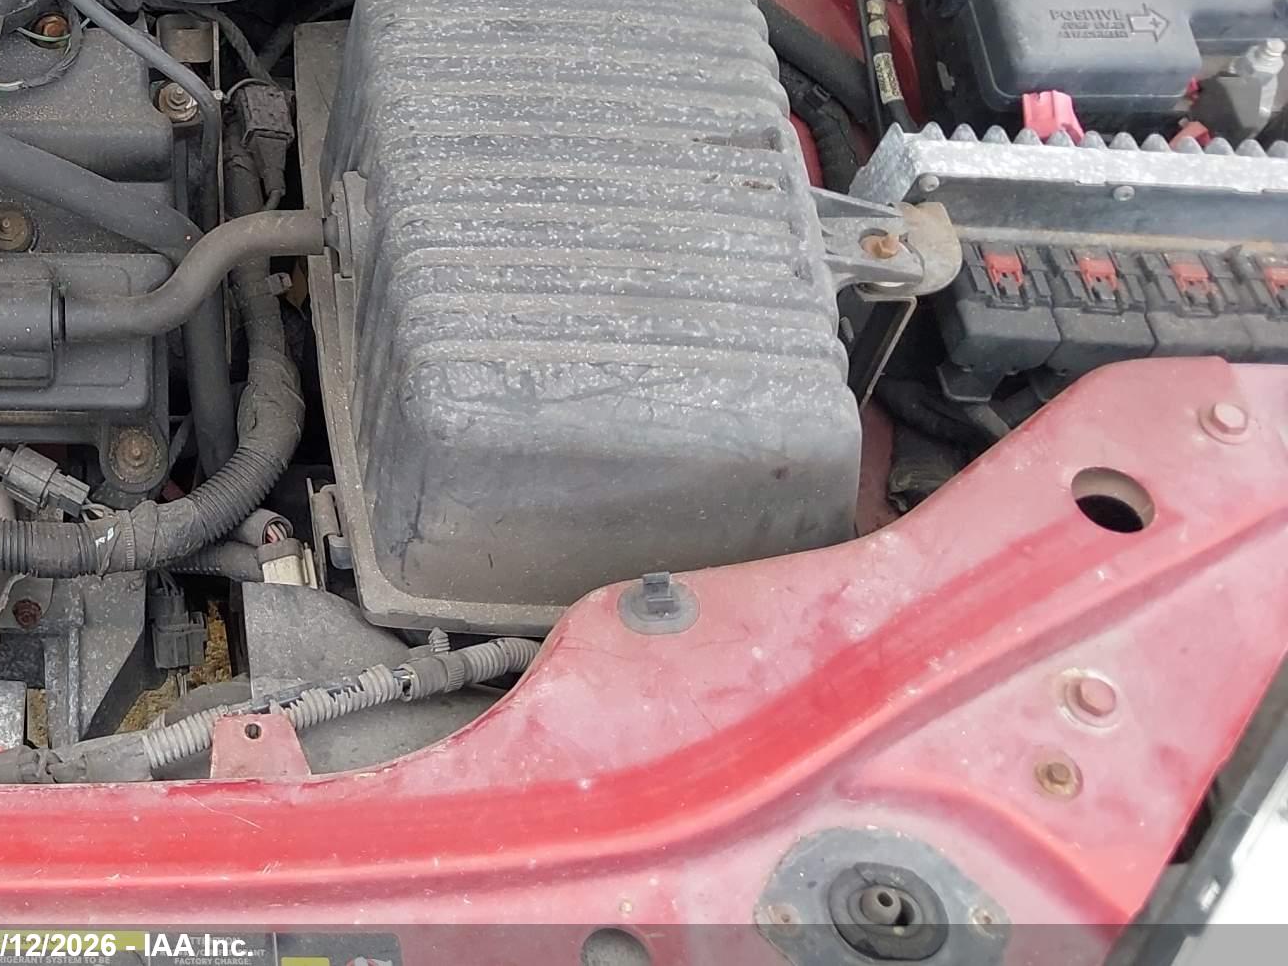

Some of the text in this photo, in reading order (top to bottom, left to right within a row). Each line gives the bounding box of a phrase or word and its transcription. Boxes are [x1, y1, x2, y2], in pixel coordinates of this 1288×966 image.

[1048, 9, 1122, 21] POSITIVE
[46, 956, 82, 964] SYSTEM
[84, 956, 96, 964] TO
[98, 956, 111, 964] BE
[174, 957, 214, 966] FACTORY
